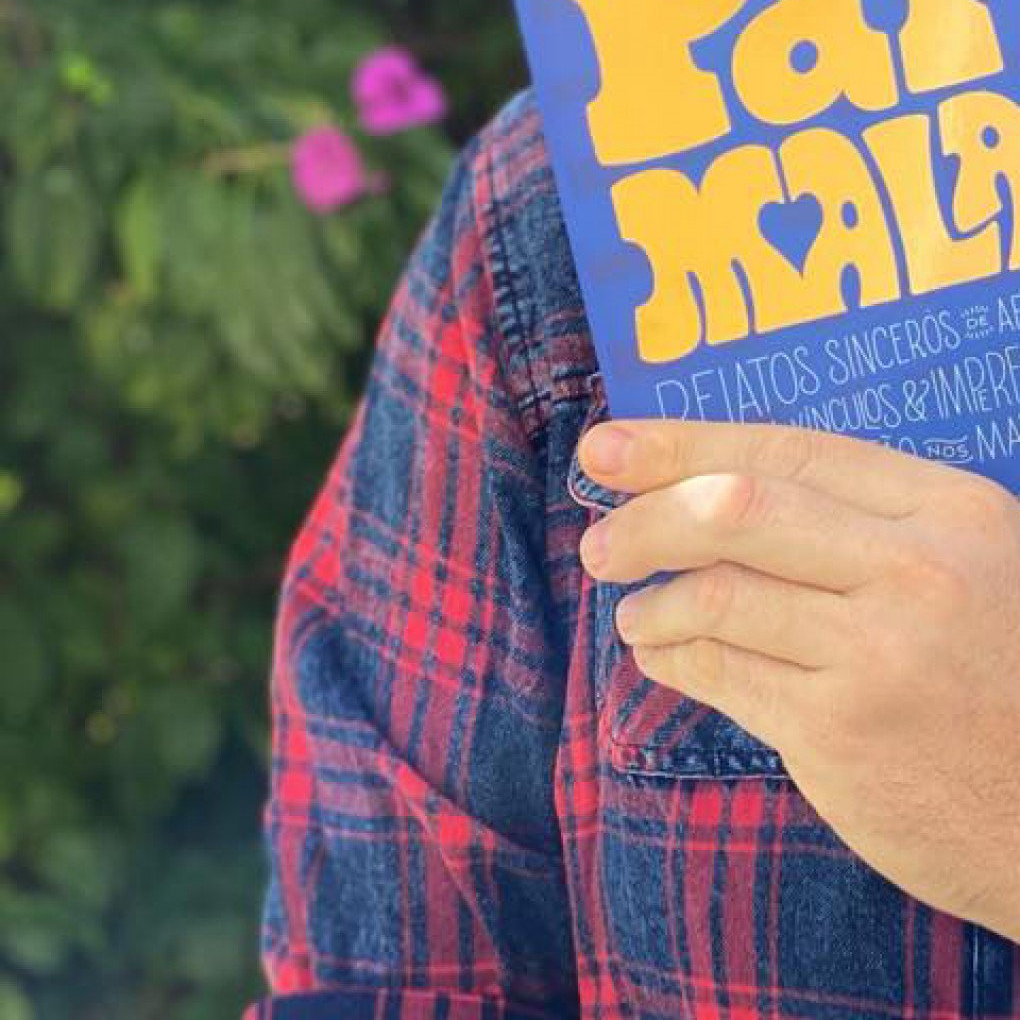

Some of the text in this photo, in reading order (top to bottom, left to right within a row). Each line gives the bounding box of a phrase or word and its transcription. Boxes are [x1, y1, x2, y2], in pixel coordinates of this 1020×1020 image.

[824, 309, 961, 385] SINCEROS
[966, 316, 988, 329] DE
[902, 379, 931, 422] &
[927, 443, 969, 458] NOS
